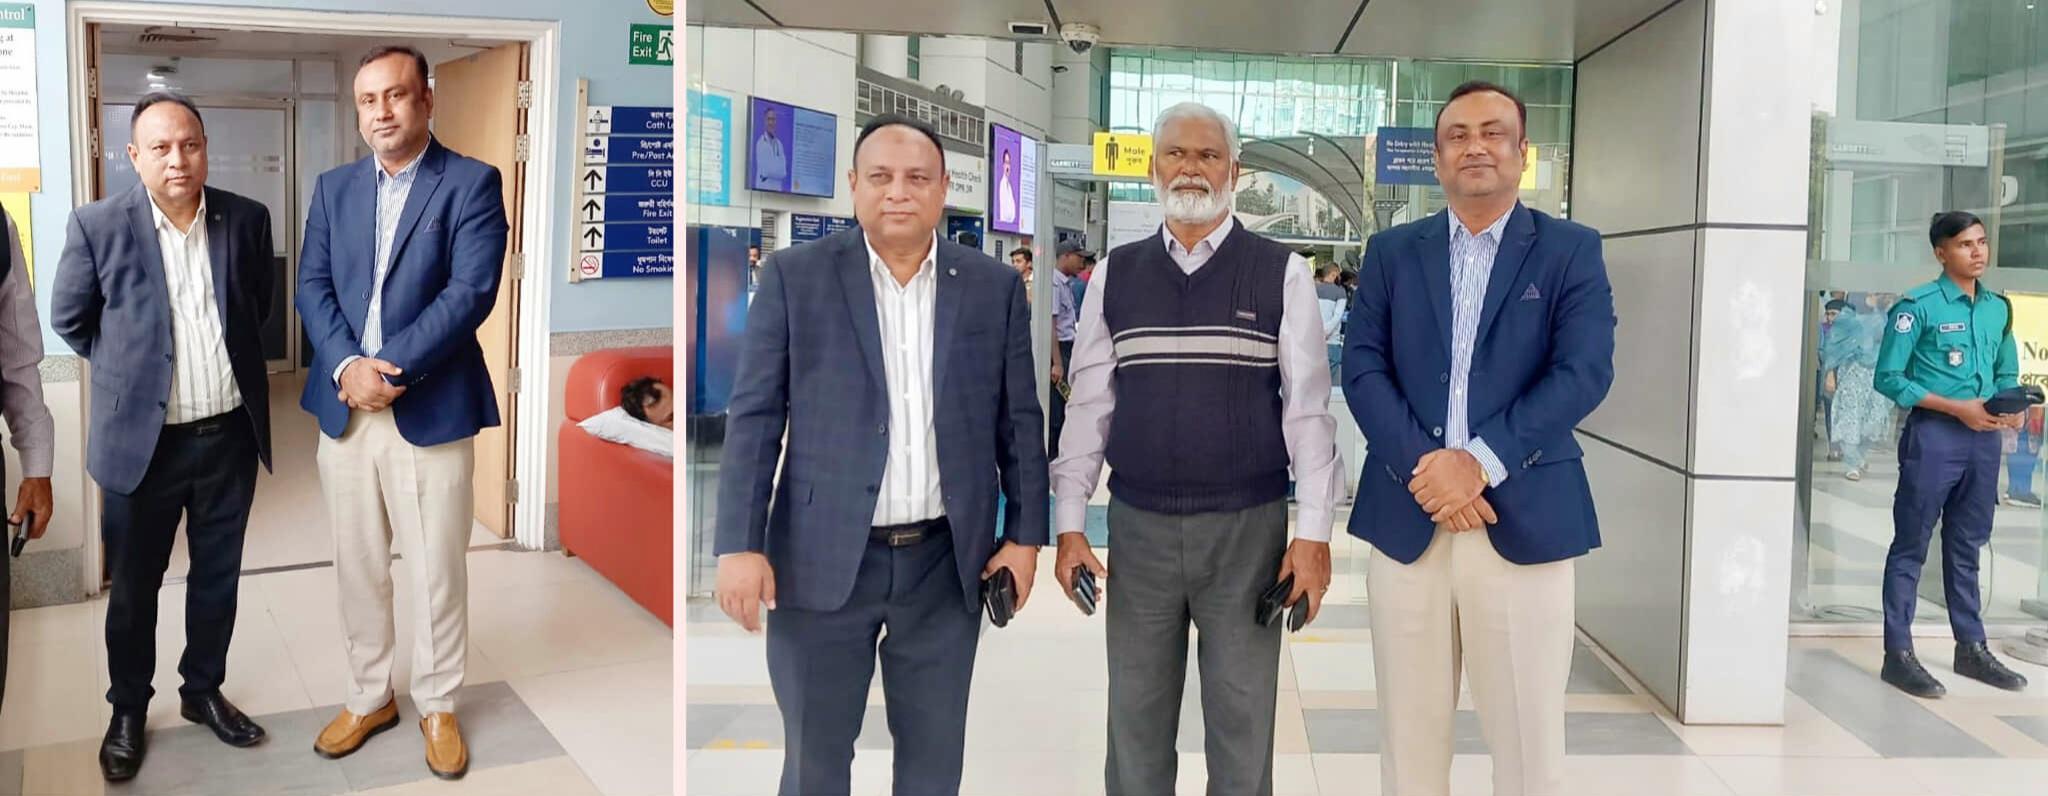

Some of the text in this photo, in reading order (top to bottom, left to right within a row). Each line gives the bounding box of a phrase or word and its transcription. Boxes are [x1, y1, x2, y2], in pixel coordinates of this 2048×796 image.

[633, 31, 653, 43] Fire
[632, 46, 652, 58] Exit
[646, 120, 665, 129] Cath
[632, 151, 665, 160] Pre/Post
[1124, 147, 1145, 156] Male
[650, 179, 668, 188] CCU
[643, 209, 673, 218] Fire Exit
[647, 236, 668, 245] Toilet
[632, 265, 644, 274] No
